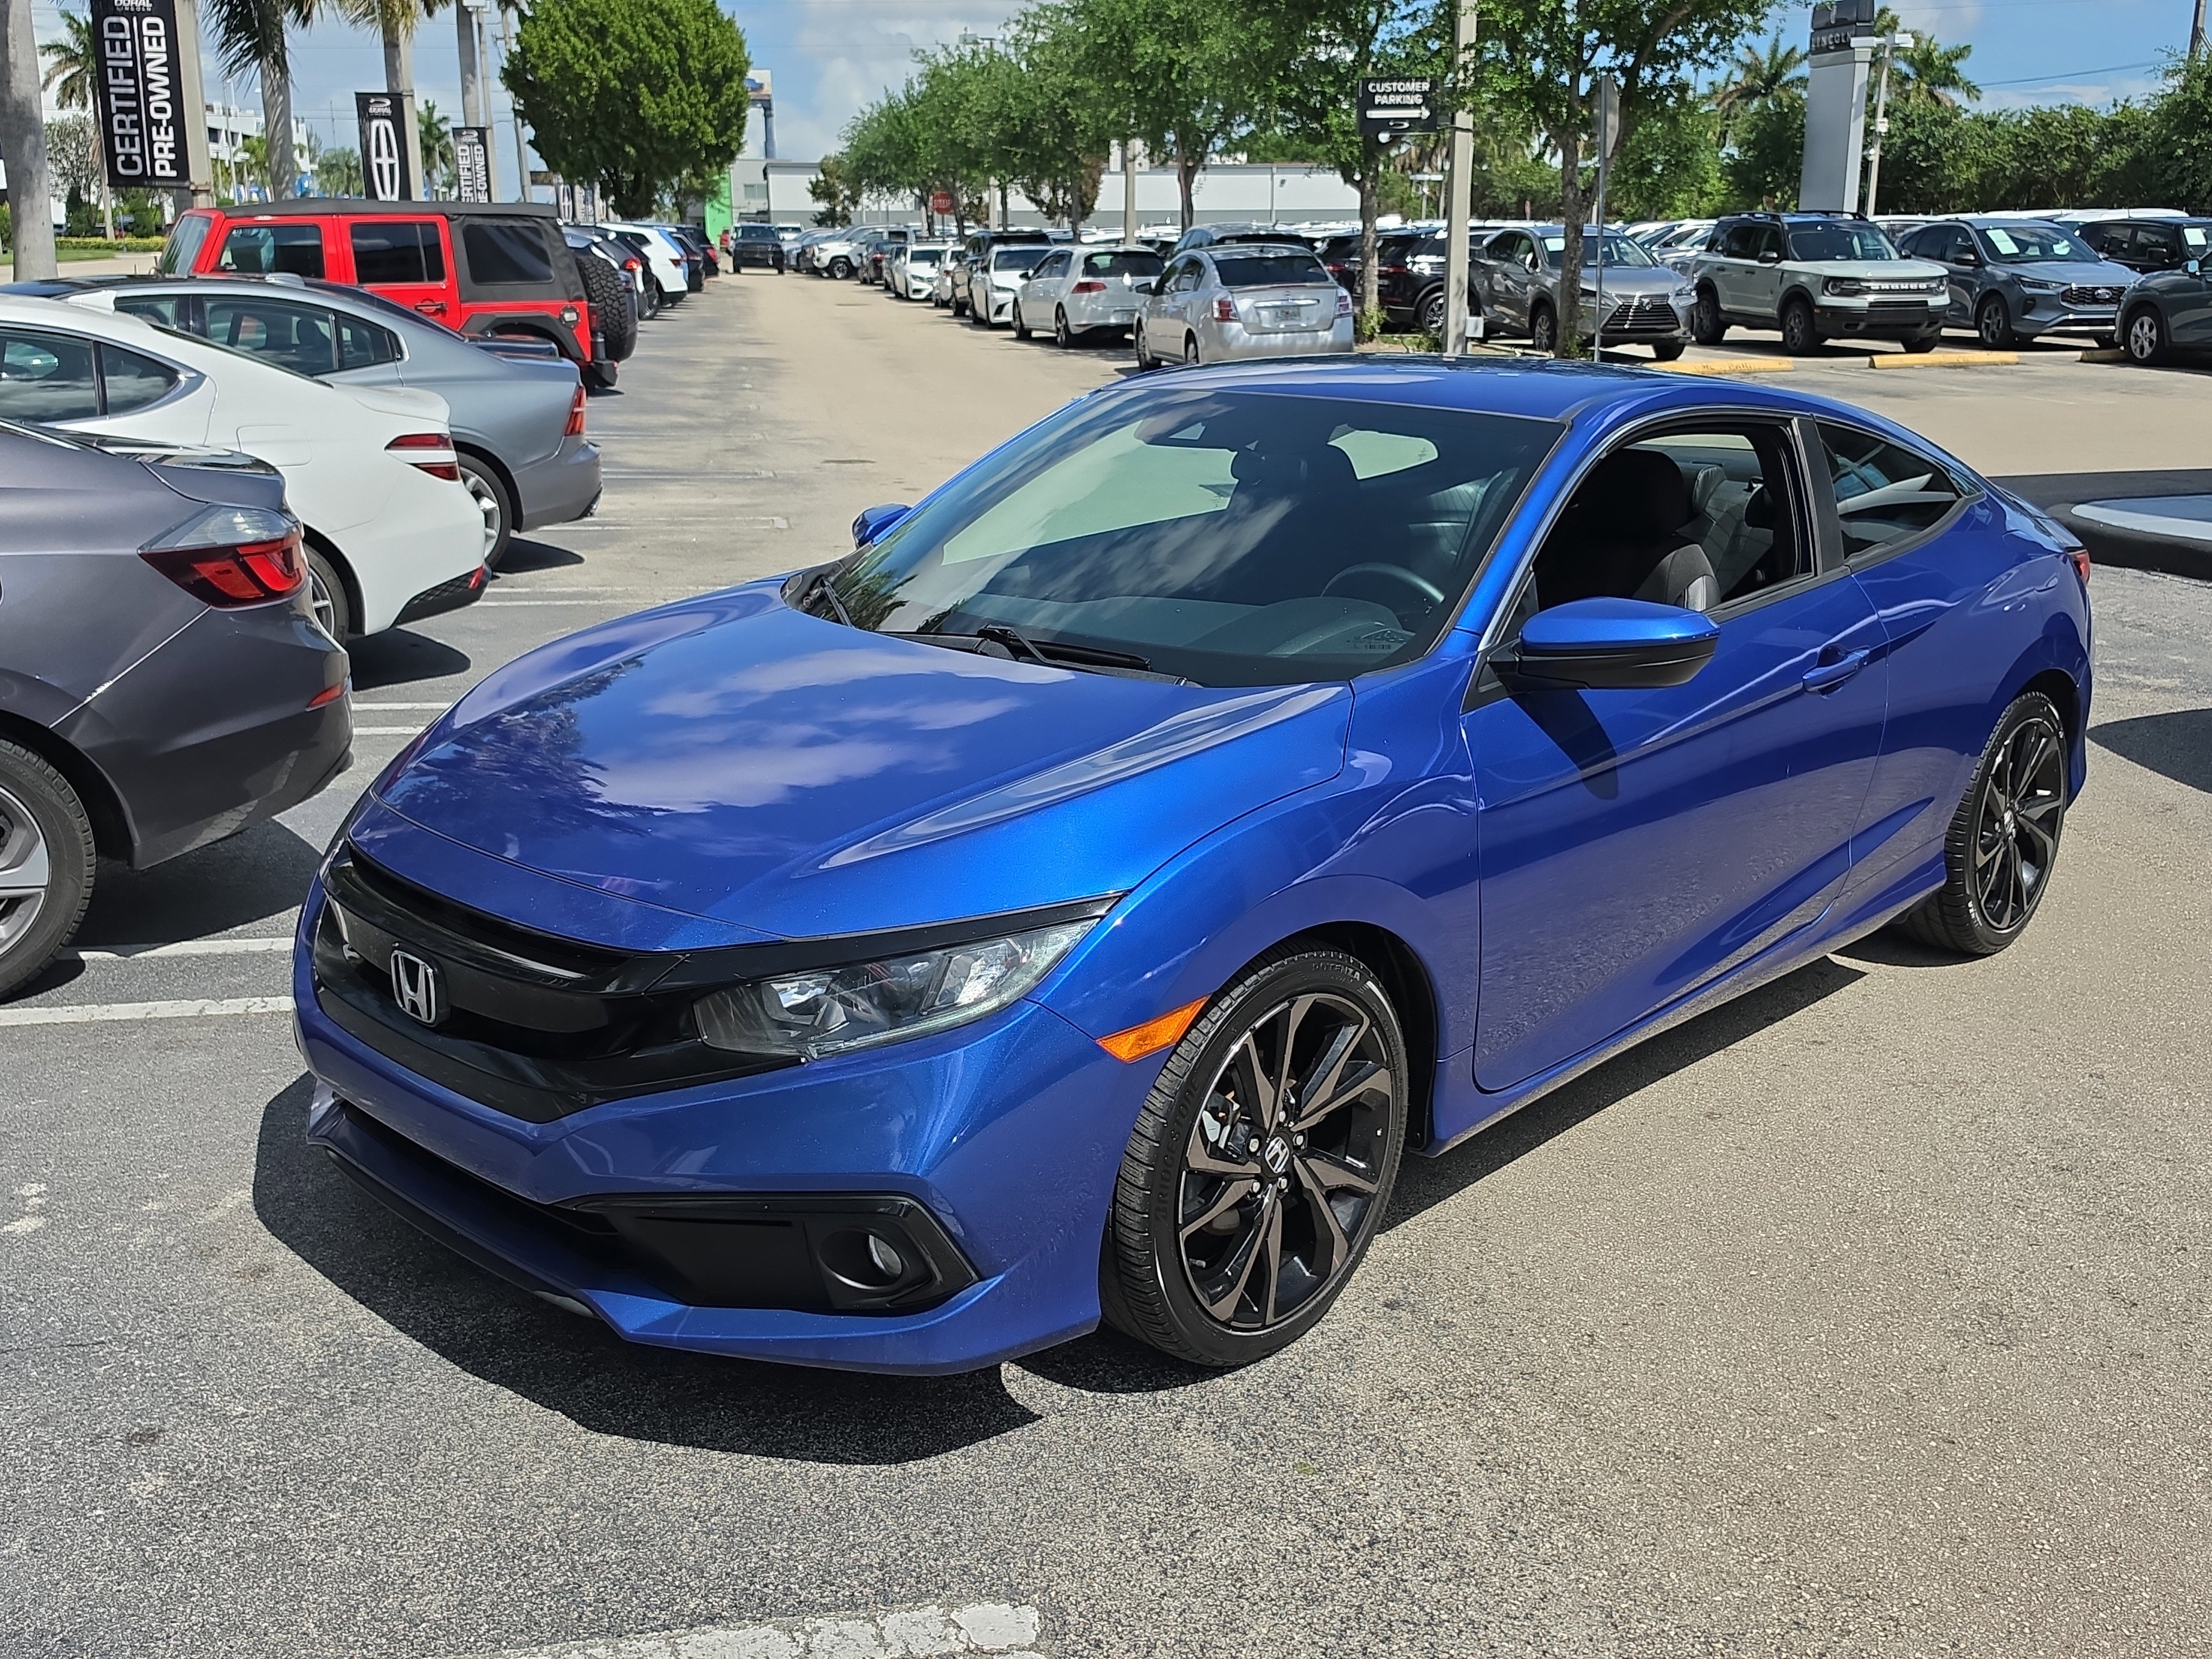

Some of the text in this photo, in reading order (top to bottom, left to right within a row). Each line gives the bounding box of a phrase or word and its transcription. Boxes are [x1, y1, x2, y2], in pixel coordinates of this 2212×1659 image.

[102, 15, 143, 176] CERTIFIED
[142, 16, 177, 177] PRE-OWNED
[1367, 81, 1430, 93] CUSTOMER
[1374, 94, 1424, 105] PARKING
[456, 144, 474, 203] ERTIFIED
